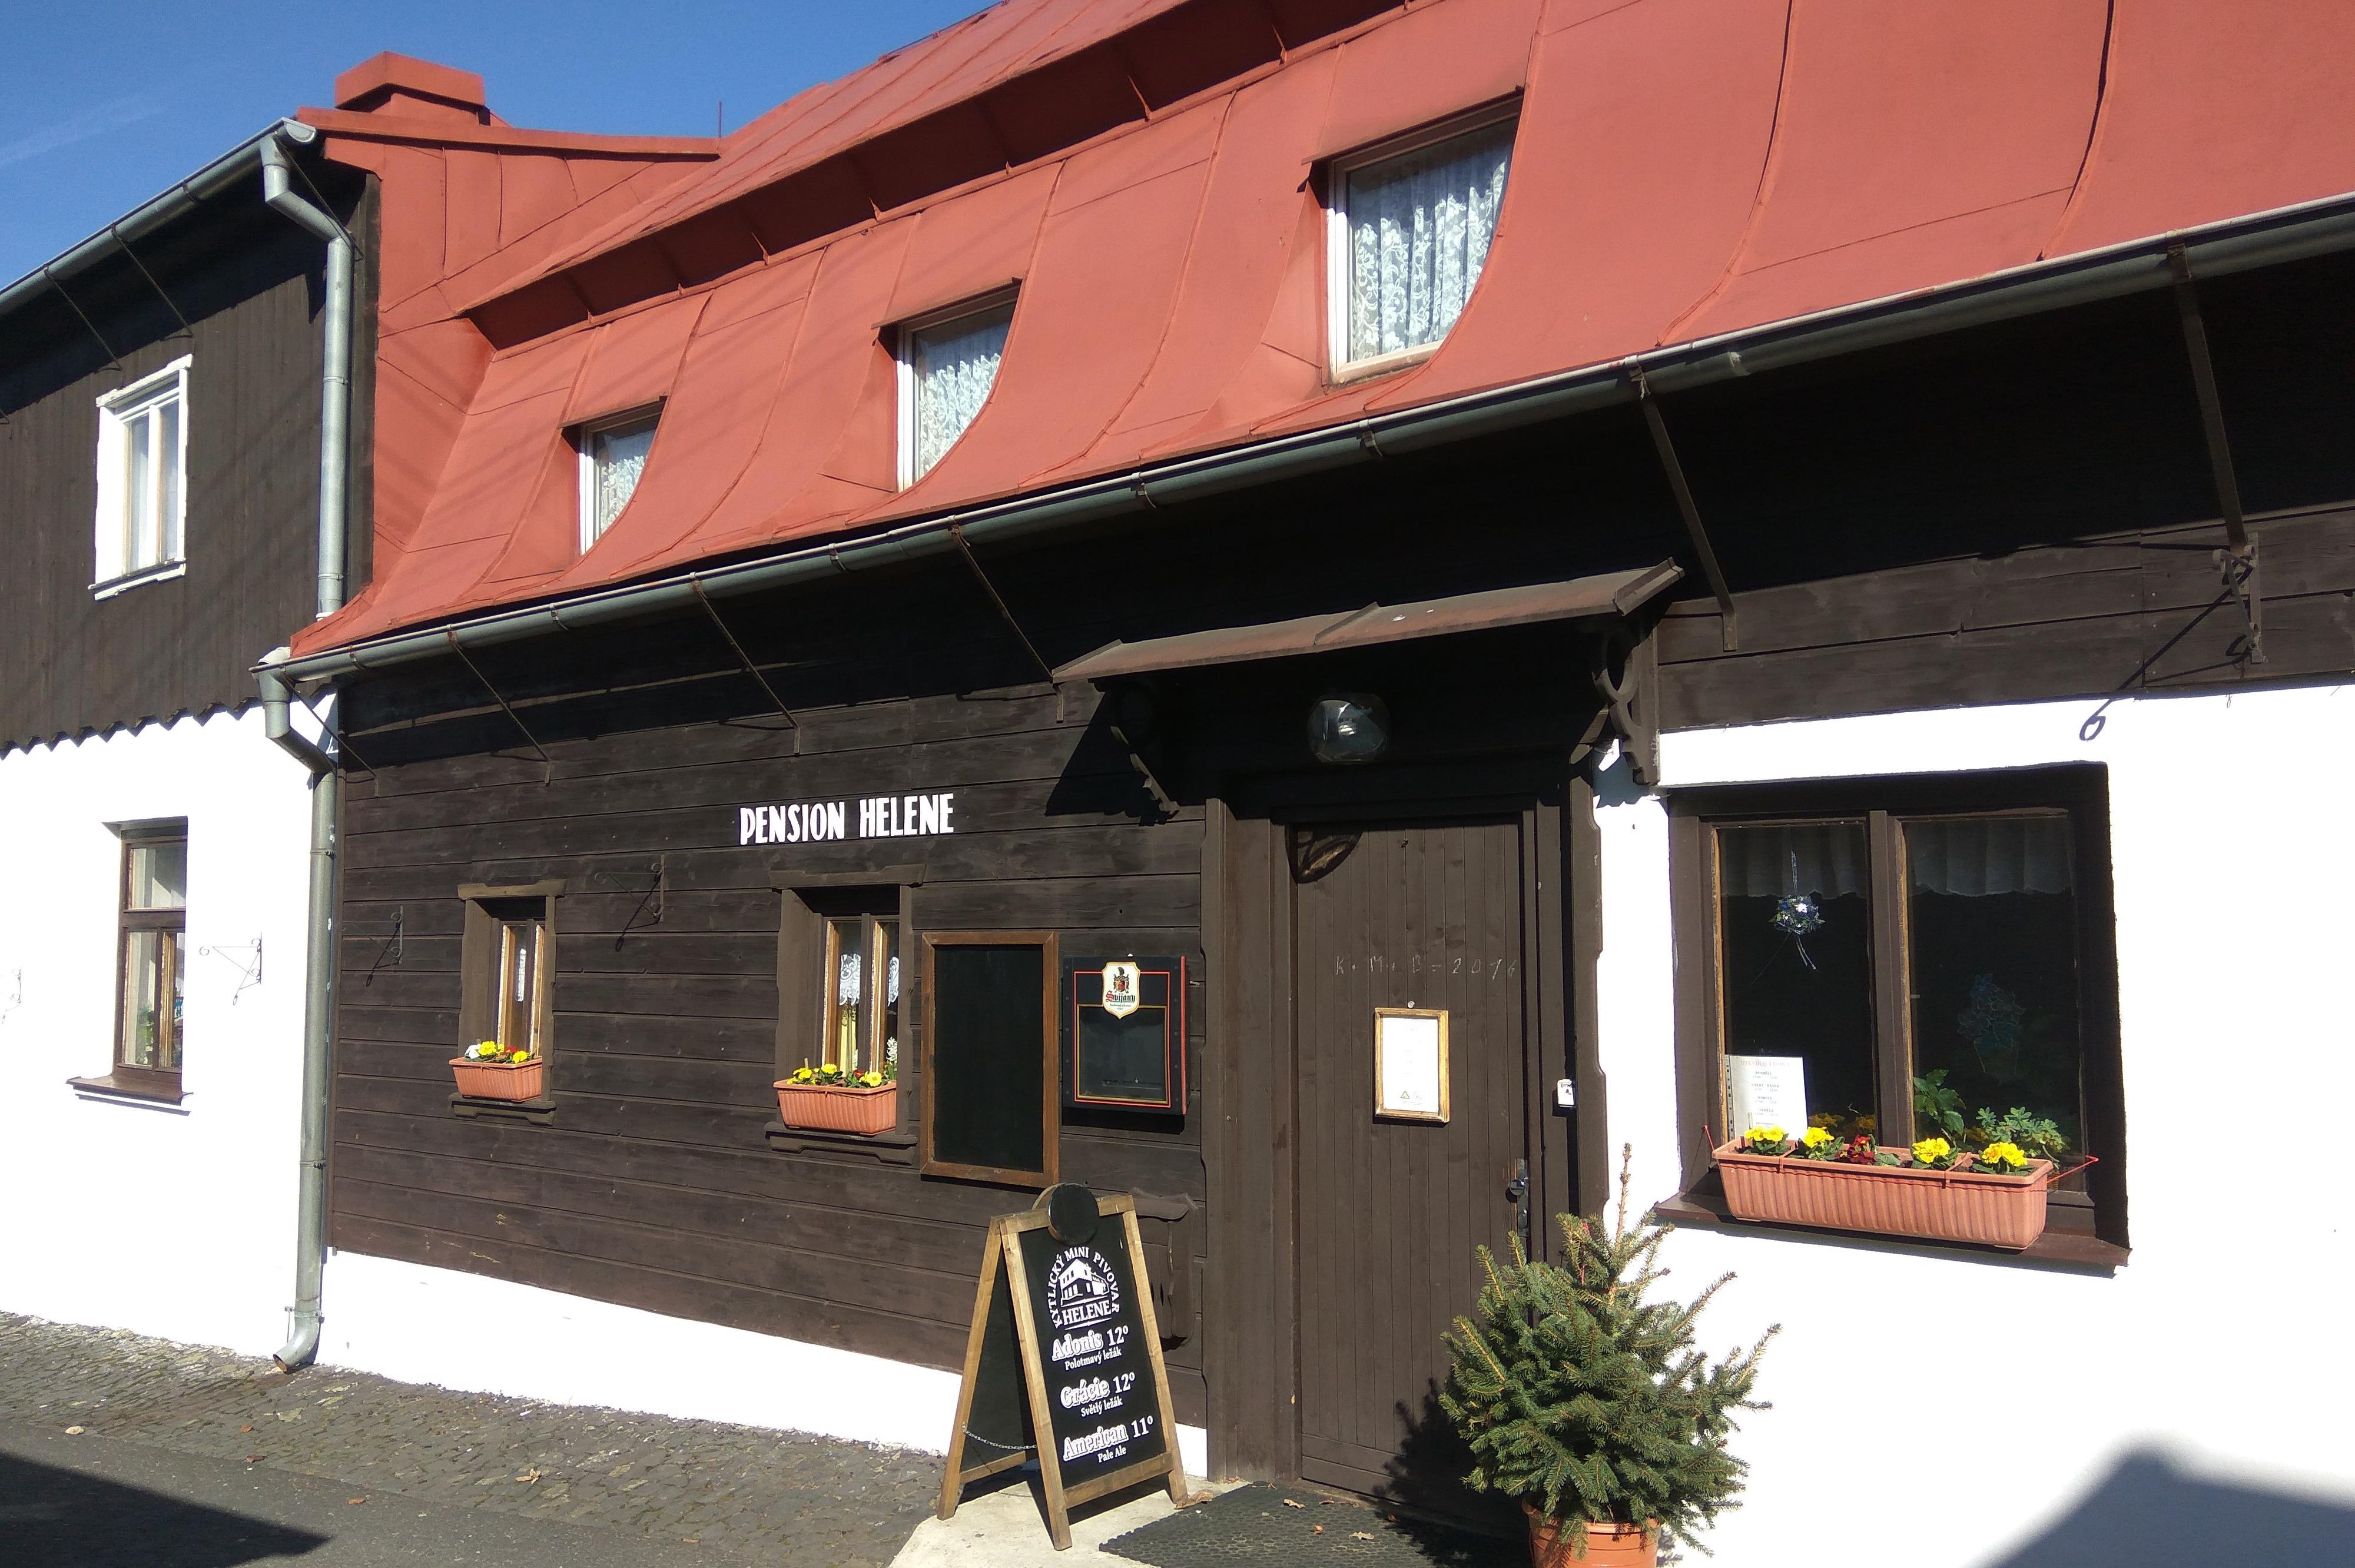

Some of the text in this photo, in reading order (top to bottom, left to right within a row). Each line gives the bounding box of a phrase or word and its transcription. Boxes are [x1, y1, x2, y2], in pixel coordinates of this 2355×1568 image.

[740, 793, 954, 846] PENSION HELENE
[1106, 990, 1136, 1003] Svijany
[1048, 1246, 1120, 1329] KYTLICKÝ MINI PIVOVAR
[1062, 1300, 1112, 1326] HELENE
[1052, 1330, 1104, 1362] Adonis
[1064, 1346, 1122, 1371] Polotmavý ležák
[1060, 1377, 1110, 1408] Grácie
[1080, 1396, 1123, 1417] Světlý ležák
[1063, 1424, 1129, 1461] American
[1097, 1444, 1127, 1463] Pale Ale
